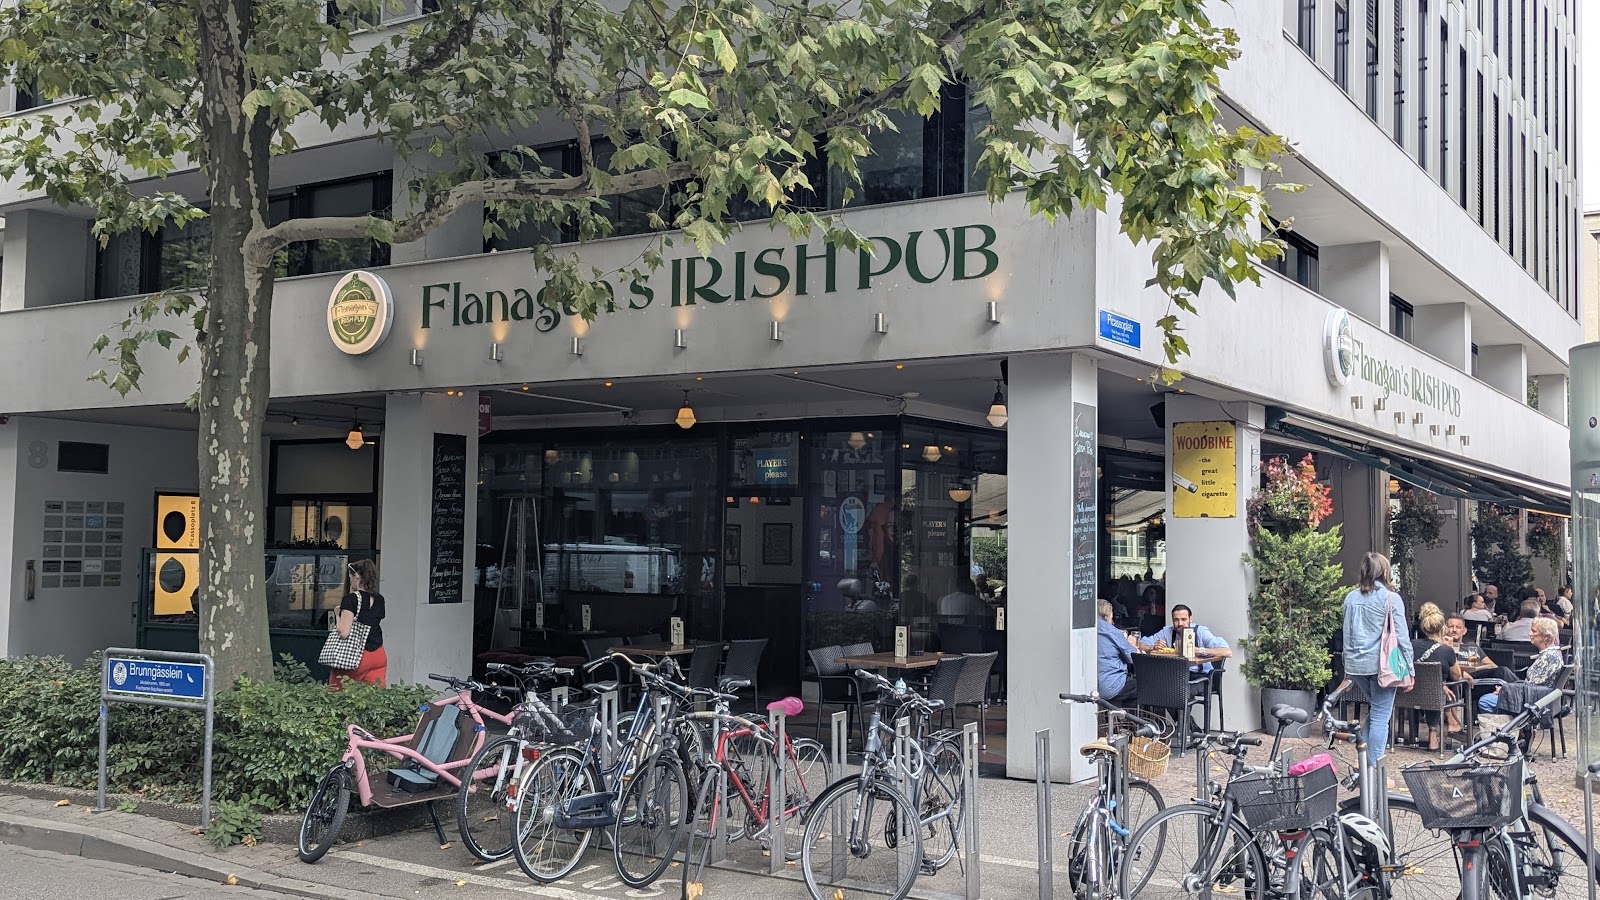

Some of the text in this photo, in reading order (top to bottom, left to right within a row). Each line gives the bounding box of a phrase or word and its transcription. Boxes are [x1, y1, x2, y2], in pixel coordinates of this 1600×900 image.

[671, 241, 837, 307] IRISH
[858, 224, 999, 290] PUB
[1352, 338, 1461, 418] Flanagan's IRISH PUB
[1176, 436, 1233, 450] WOODBINE
[28, 440, 48, 468] 8
[756, 458, 787, 468] PLAYER'S
[765, 469, 788, 481] please
[1201, 468, 1218, 476] great
[1201, 490, 1228, 498] cigarette
[188, 505, 196, 547] Picassoplatz
[927, 529, 947, 538] please
[129, 662, 183, 681] Brunngässlein
